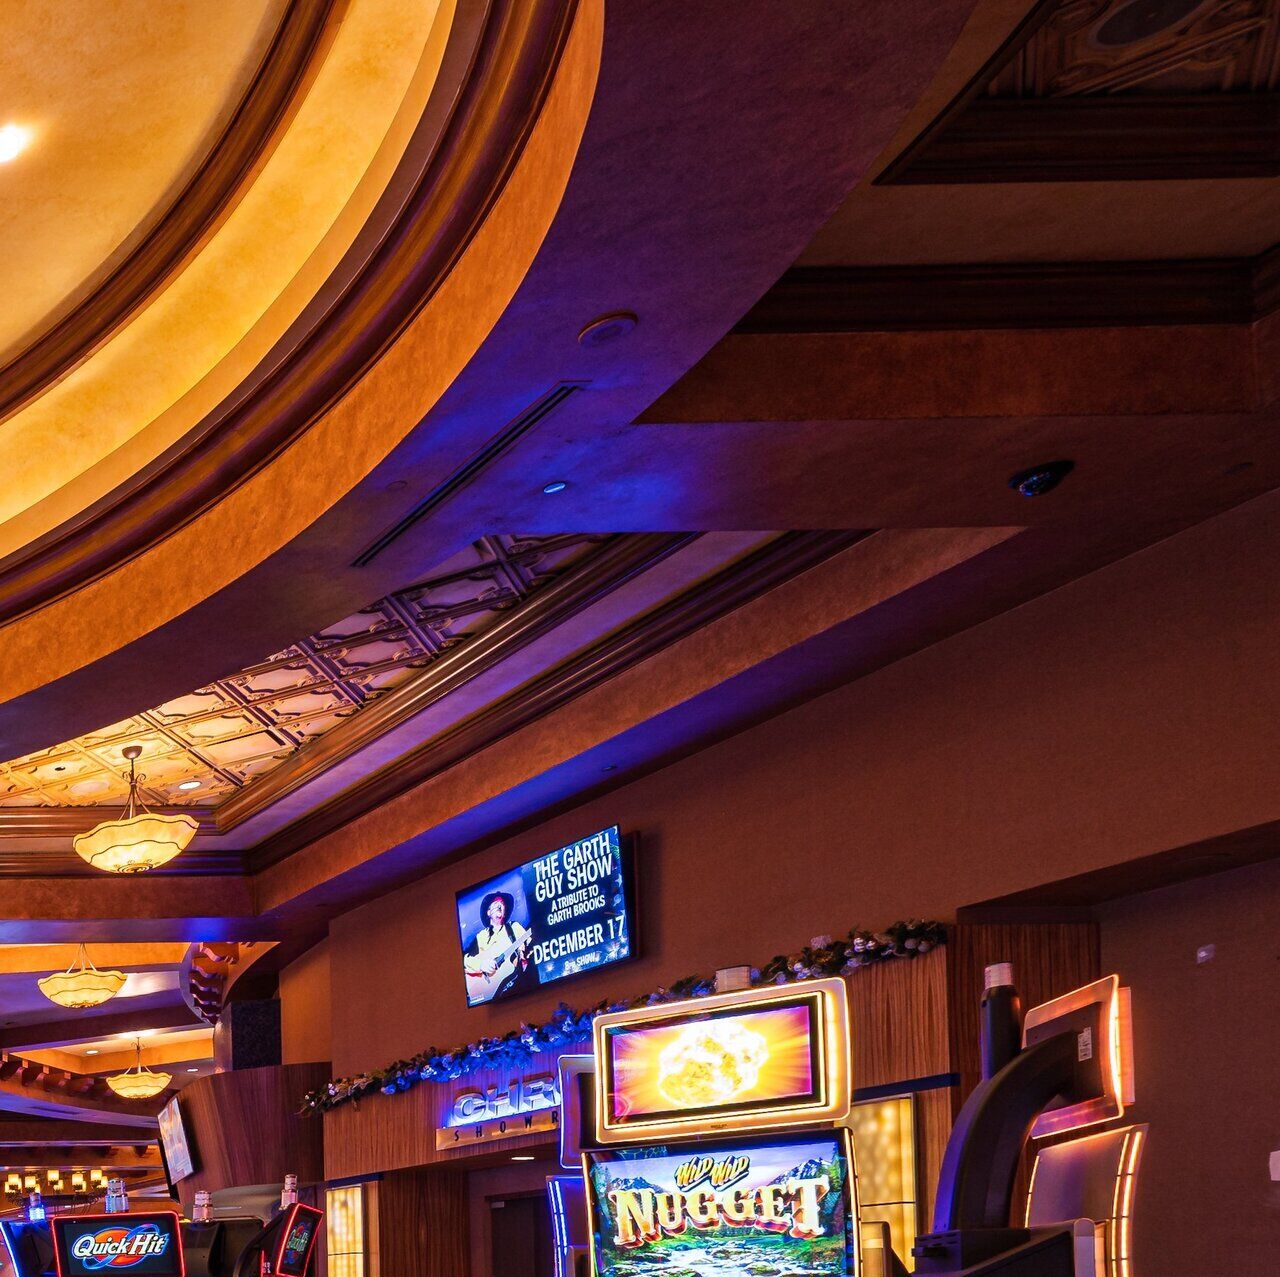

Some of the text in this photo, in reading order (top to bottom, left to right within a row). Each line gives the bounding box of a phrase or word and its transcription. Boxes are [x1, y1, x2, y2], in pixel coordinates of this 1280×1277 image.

[533, 833, 610, 882] THE GARTH
[535, 853, 613, 903] GUY SHOW
[547, 895, 606, 926] GARTH BROOKS
[551, 884, 599, 912] A TRIBUTE TO
[533, 915, 625, 965] DECEMBER 17
[610, 1175, 830, 1248] NUGGET
[73, 1233, 168, 1258] Quick Hit
